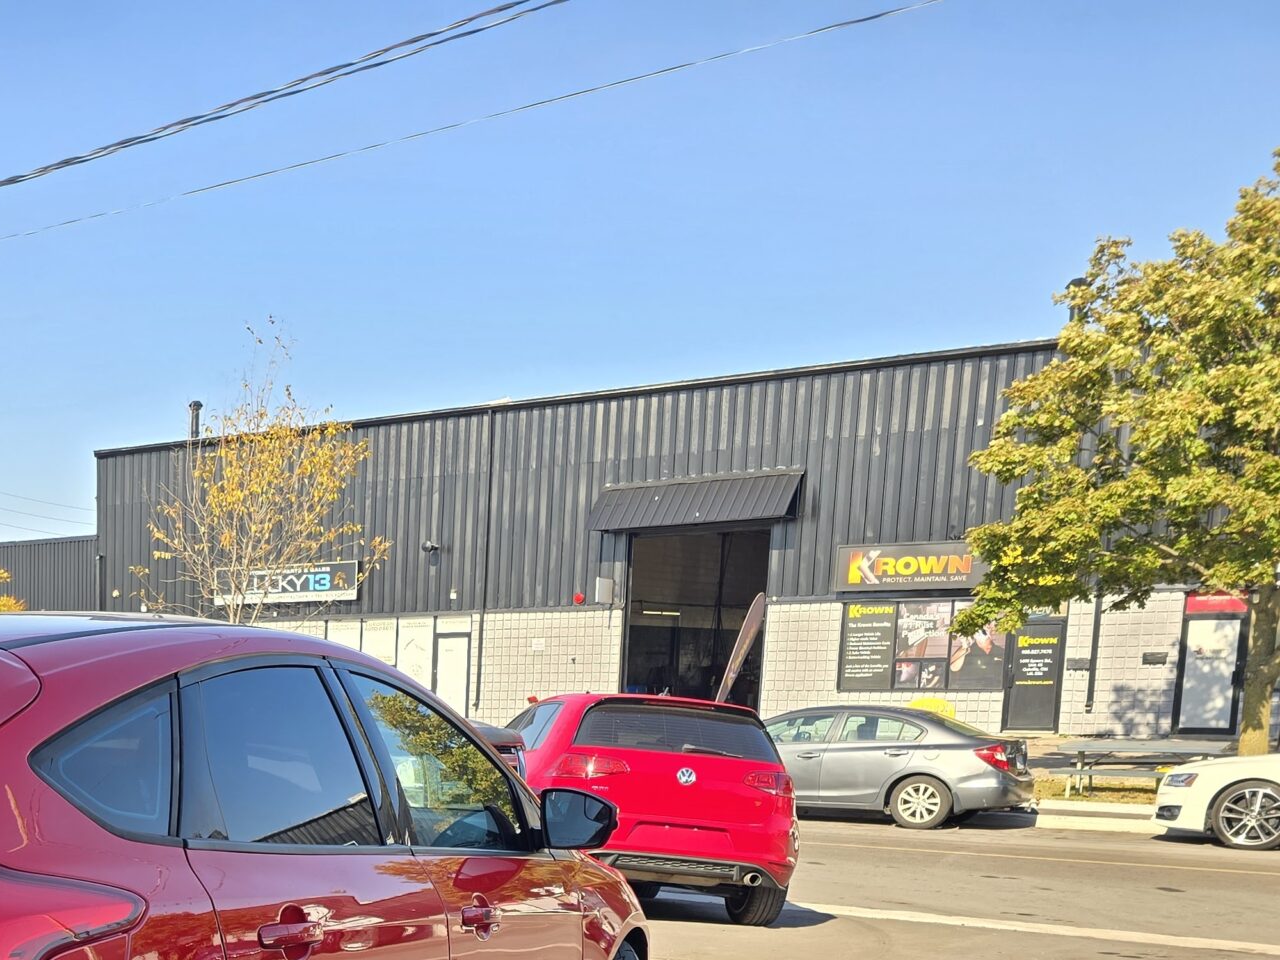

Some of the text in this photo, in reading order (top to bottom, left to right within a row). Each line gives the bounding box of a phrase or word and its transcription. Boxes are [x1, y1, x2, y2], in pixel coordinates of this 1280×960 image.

[848, 550, 972, 585] KROWN
[243, 573, 331, 594] UCKY13
[848, 604, 894, 618] KROWN
[1018, 636, 1059, 648] KROWN
